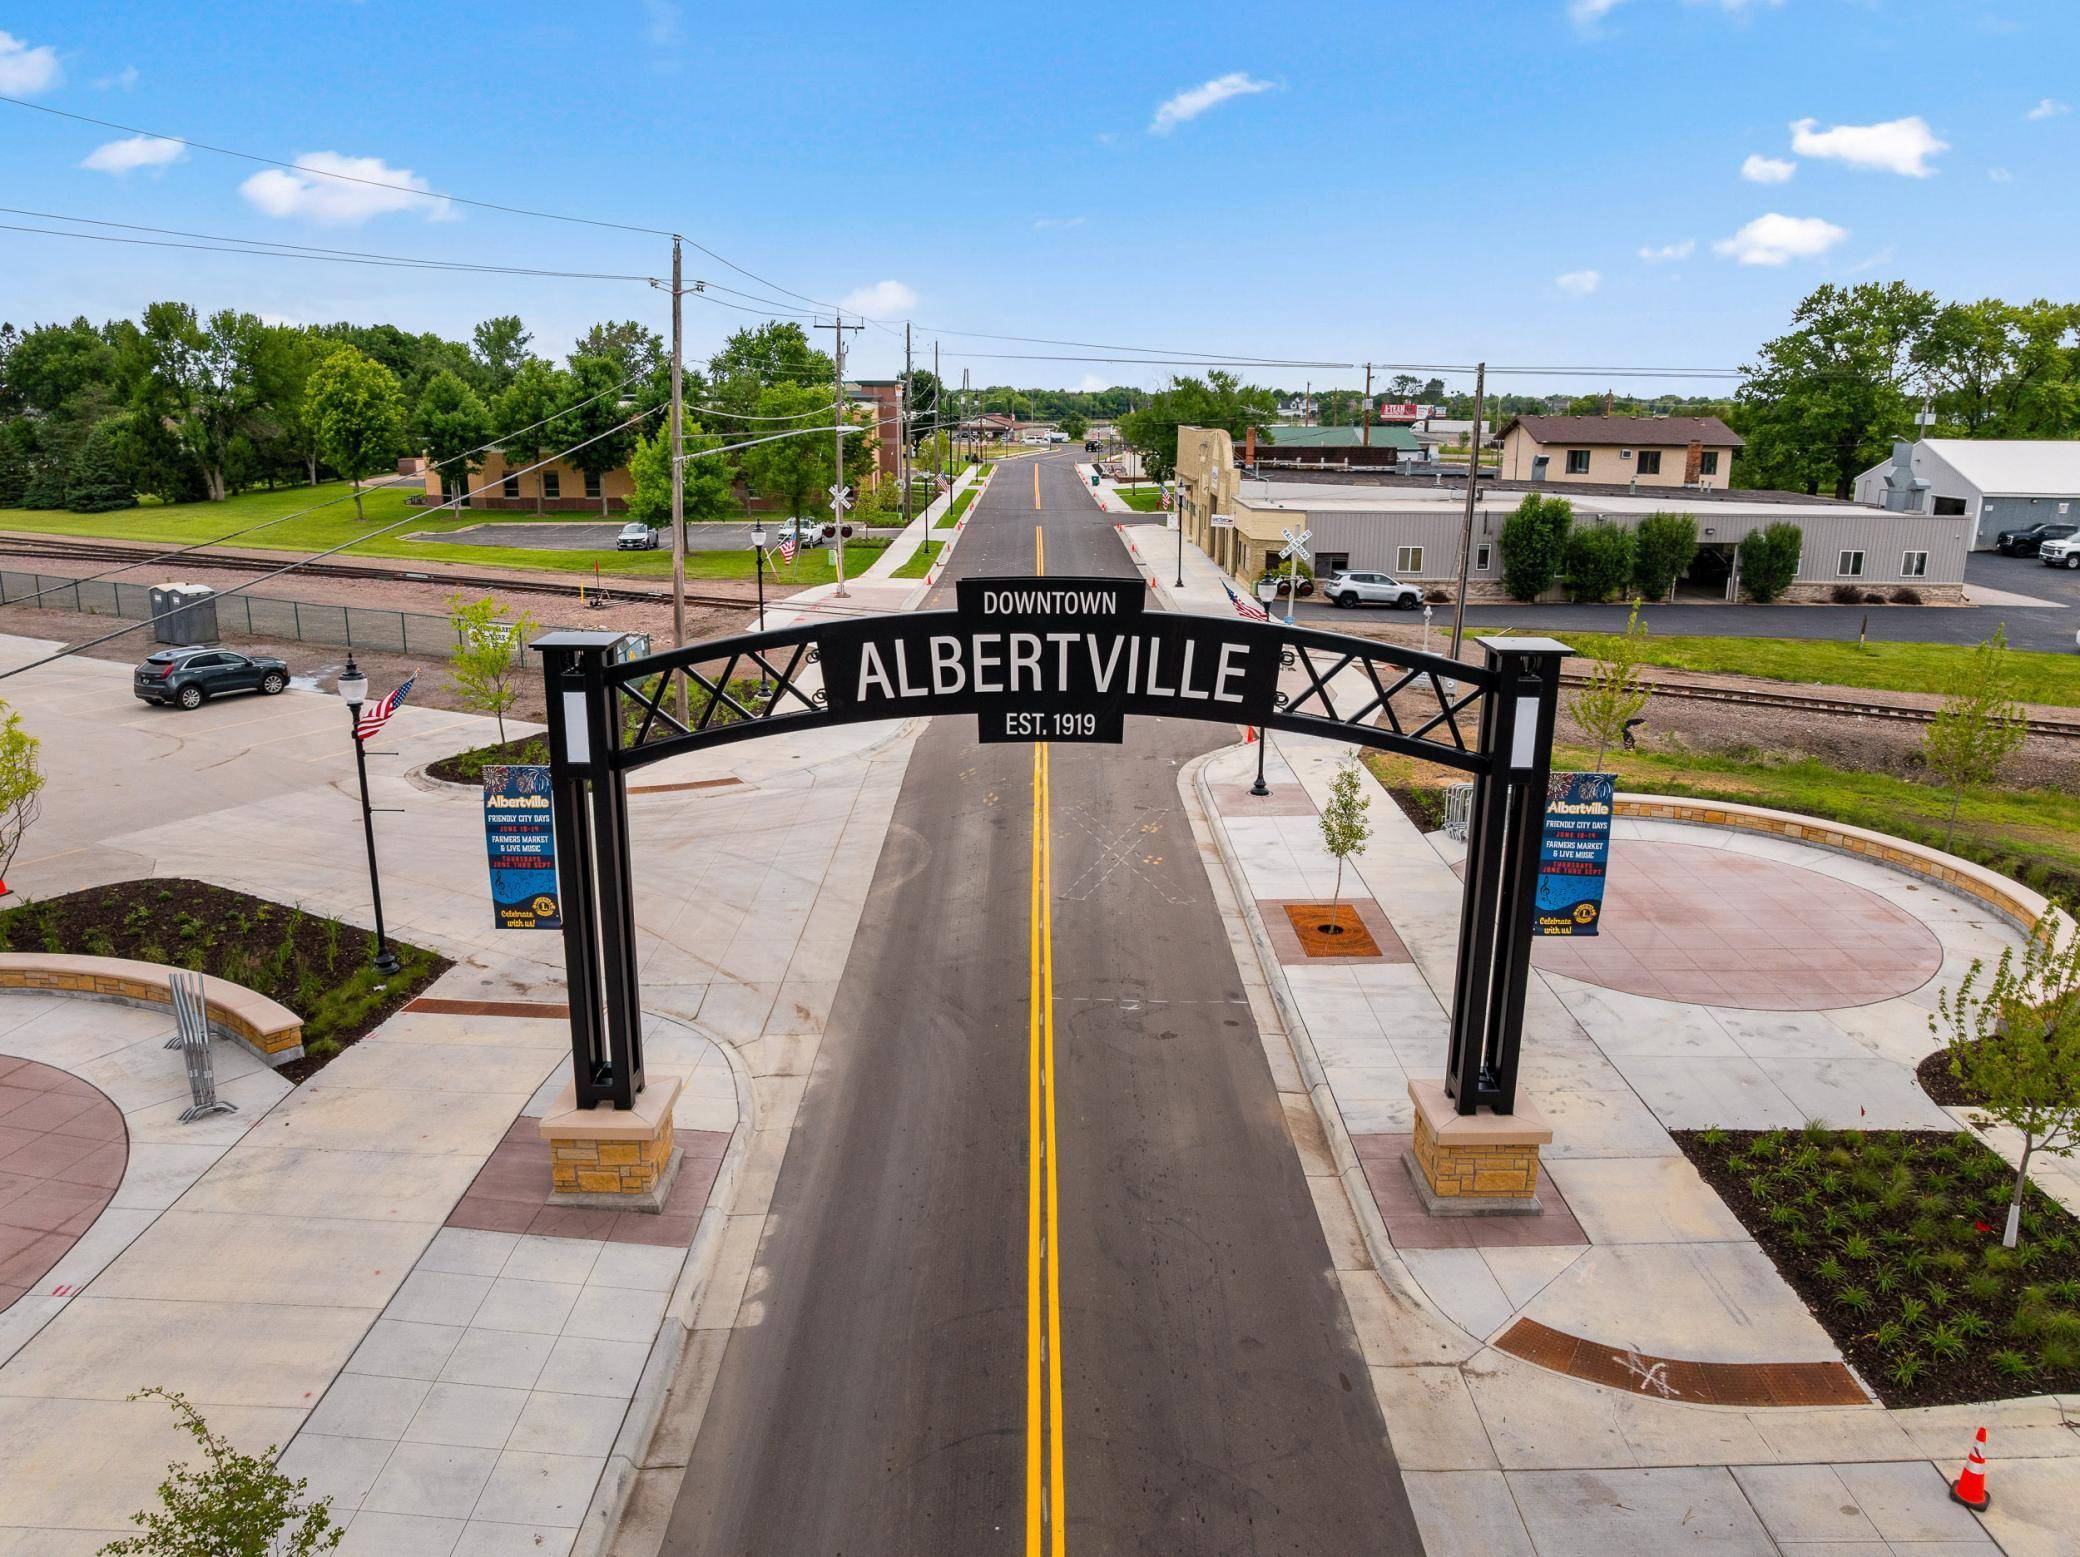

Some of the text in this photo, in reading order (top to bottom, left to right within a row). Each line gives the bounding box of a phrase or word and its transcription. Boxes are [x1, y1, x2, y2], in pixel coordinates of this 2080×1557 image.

[984, 591, 1116, 615] DOWNTOWN
[857, 633, 1250, 703] ALBERTVILLE
[1006, 713, 1096, 735] EST. 1919
[487, 794, 550, 808] Albertville
[1546, 801, 1609, 815] Albertville
[1546, 820, 1575, 828] FRIENDLY
[1576, 821, 1591, 829] CITY
[1546, 841, 1575, 849] FARMERS
[501, 910, 534, 918] Celebrate
[507, 919, 535, 927] with us!
[1539, 917, 1572, 925] Celebrate
[1544, 926, 1572, 934] with us!
